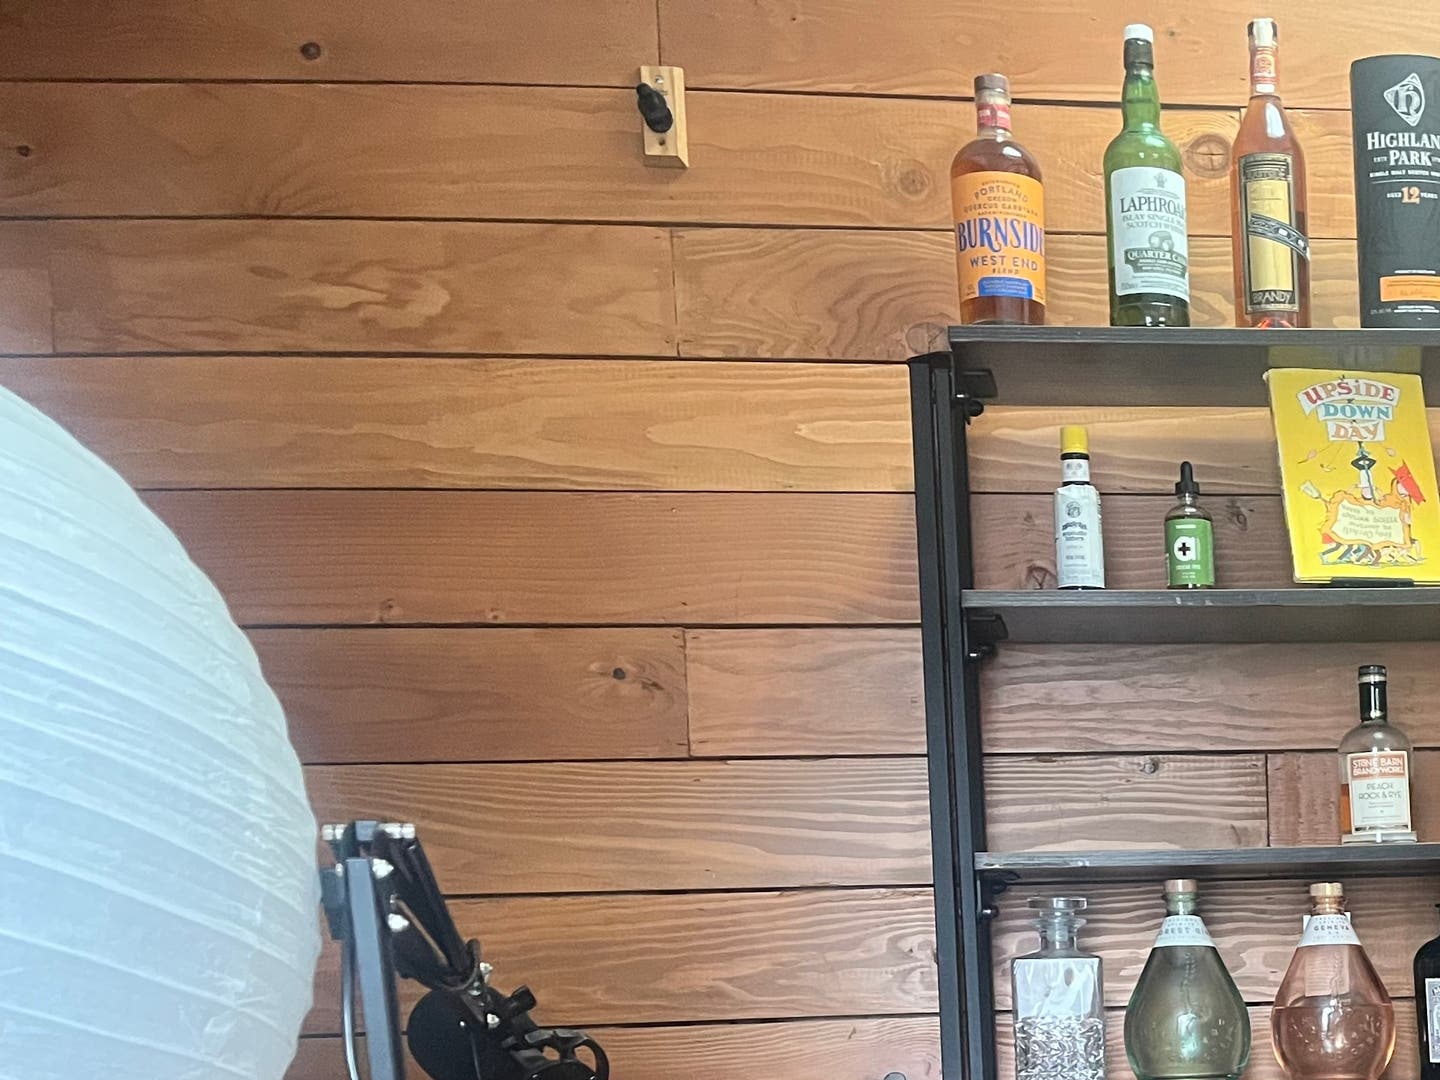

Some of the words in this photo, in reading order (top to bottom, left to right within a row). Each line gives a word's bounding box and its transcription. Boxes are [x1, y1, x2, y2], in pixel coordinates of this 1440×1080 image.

[1389, 150, 1432, 166] PARK
[1401, 186, 1420, 204] 12
[1120, 196, 1185, 219] LAPHROA
[969, 255, 1006, 268] WEST
[1012, 256, 1039, 271] END
[1252, 291, 1292, 304] BRANDY
[1323, 403, 1391, 418] DOWN
[1331, 421, 1380, 440] DAY
